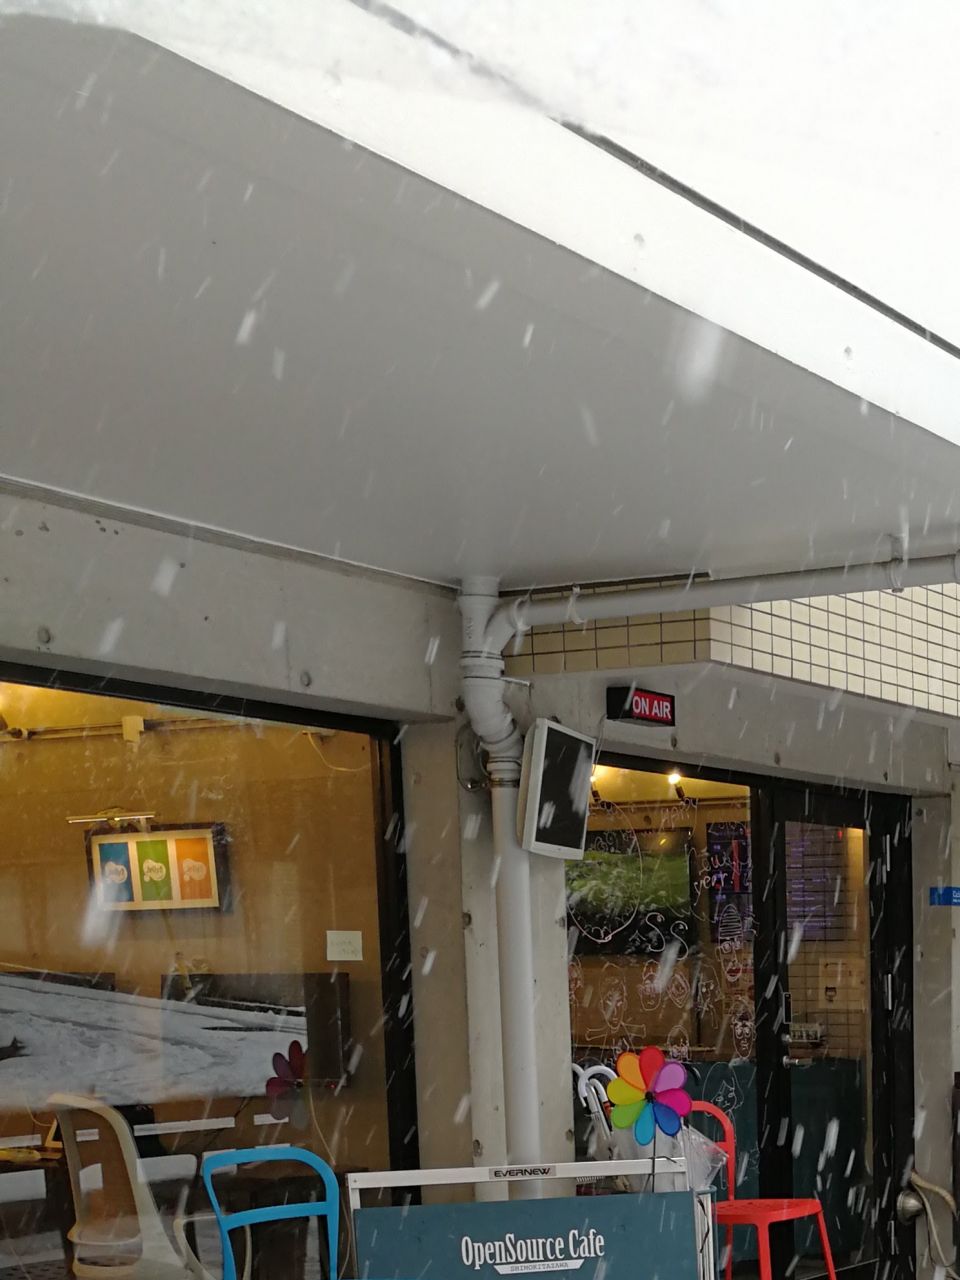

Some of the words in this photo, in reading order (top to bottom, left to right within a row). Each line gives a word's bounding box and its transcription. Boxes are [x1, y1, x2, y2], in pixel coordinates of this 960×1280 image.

[632, 695, 649, 715] ON
[651, 699, 672, 720] AIR
[494, 1168, 550, 1178] EVERNEW
[461, 1233, 565, 1270] OpenSource
[568, 1229, 605, 1258] Cafe
